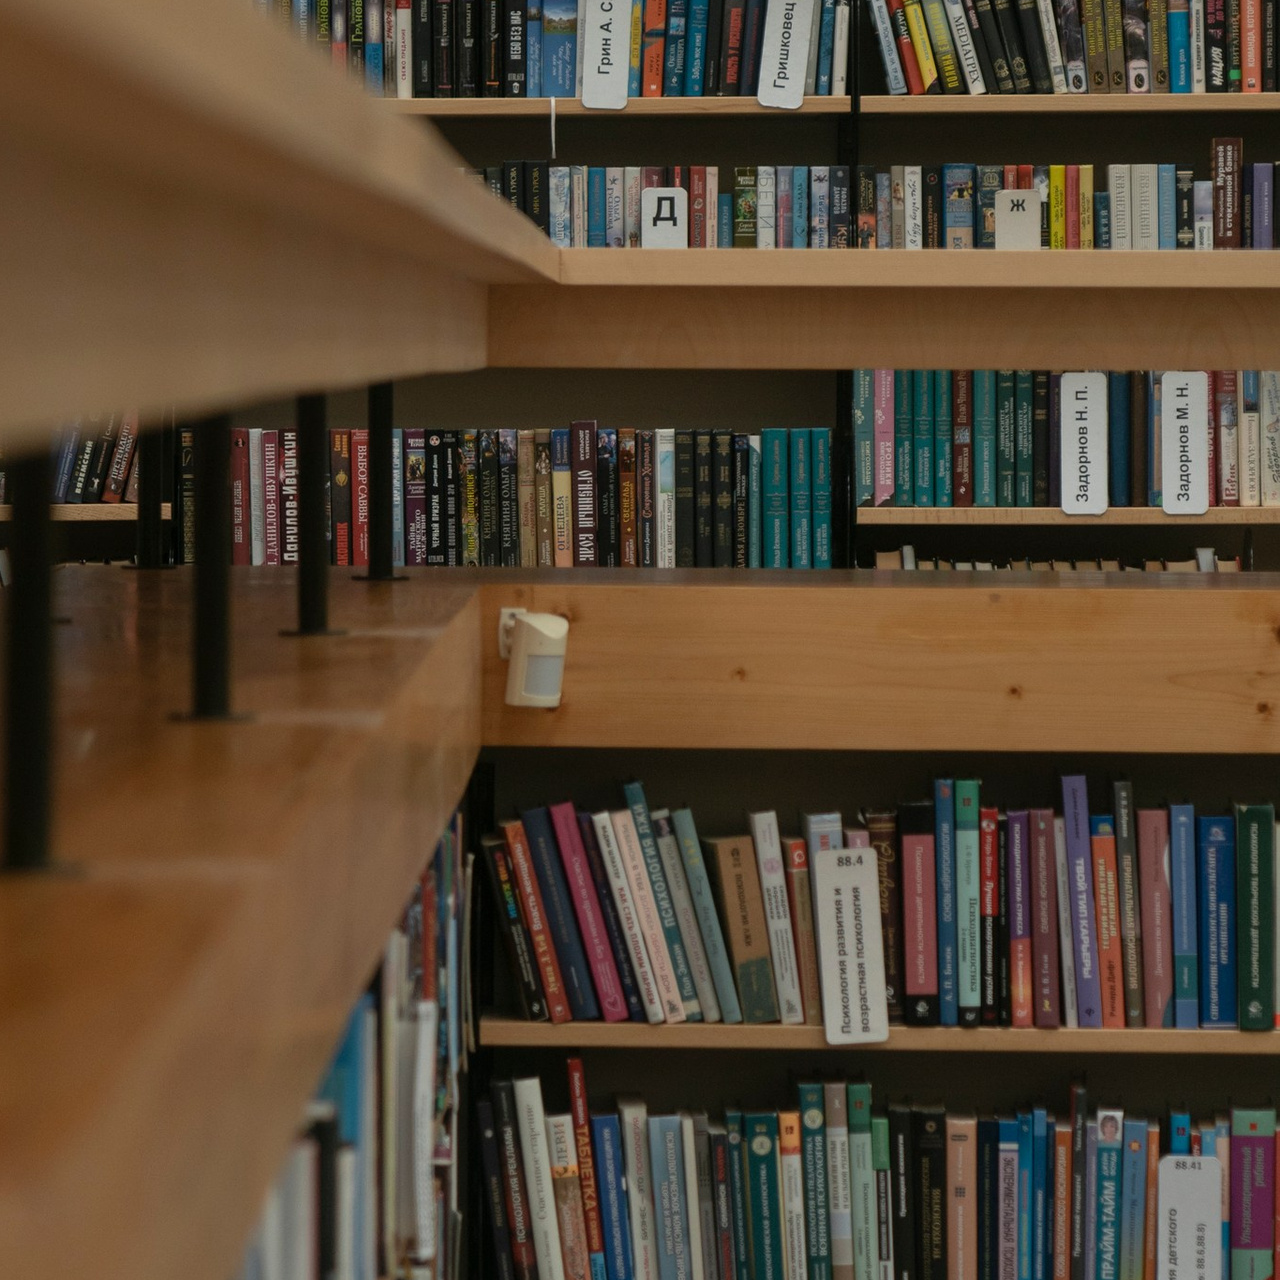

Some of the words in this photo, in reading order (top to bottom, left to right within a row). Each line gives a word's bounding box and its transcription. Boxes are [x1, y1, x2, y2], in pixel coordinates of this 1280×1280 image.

[510, 11, 522, 25] НАС
[510, 27, 522, 41] БЕЗ
[600, 18, 613, 34] А.
[898, 9, 910, 43] НАГАНТ
[511, 44, 522, 60] НЕБО
[598, 38, 614, 75] Грин
[774, 2, 796, 89] Гришковец
[1211, 48, 1223, 85] НАЦИЯ
[652, 197, 677, 227] Д
[1010, 199, 1025, 212] Ж
[1076, 387, 1088, 401] П.
[1177, 384, 1188, 398] Н.
[1076, 407, 1087, 422] Н.
[1178, 404, 1188, 420] М.
[75, 441, 94, 494] ВЯЗЕМСКИЙ
[1076, 427, 1090, 503] Задорнов
[1177, 426, 1191, 502] Задорнов
[283, 433, 298, 562] Данилов-Ивушкин
[501, 467, 510, 499] ОЛЬГА
[502, 501, 511, 548] КНЯГИНЯ
[555, 496, 565, 552] ОГНЕДЕВА
[633, 805, 650, 835] ЛЖИ
[514, 844, 535, 894] женщины
[837, 858, 863, 868] 88.4
[1076, 858, 1085, 881] ТВОЙ
[639, 839, 677, 929] ПСИХОЛОГИЯ
[833, 889, 841, 897] и
[1077, 883, 1087, 905] ТИП
[524, 897, 543, 931] Власть
[832, 900, 846, 957] развития
[852, 887, 864, 959] психология
[1079, 920, 1092, 979] КАРЬЕРЫ
[838, 960, 851, 1033] Психология
[859, 963, 870, 1032] возрастная
[503, 1127, 519, 1176] РЕКЛАМЫ
[579, 1126, 597, 1210] ТАБЛЕТКА
[1175, 1162, 1202, 1171] 88.41
[510, 1177, 527, 1243] ПСИХОЛОГИЯ
[1100, 1182, 1115, 1280] ПРАЙМ-ТАЙМ
[1166, 1209, 1178, 1267] детского
